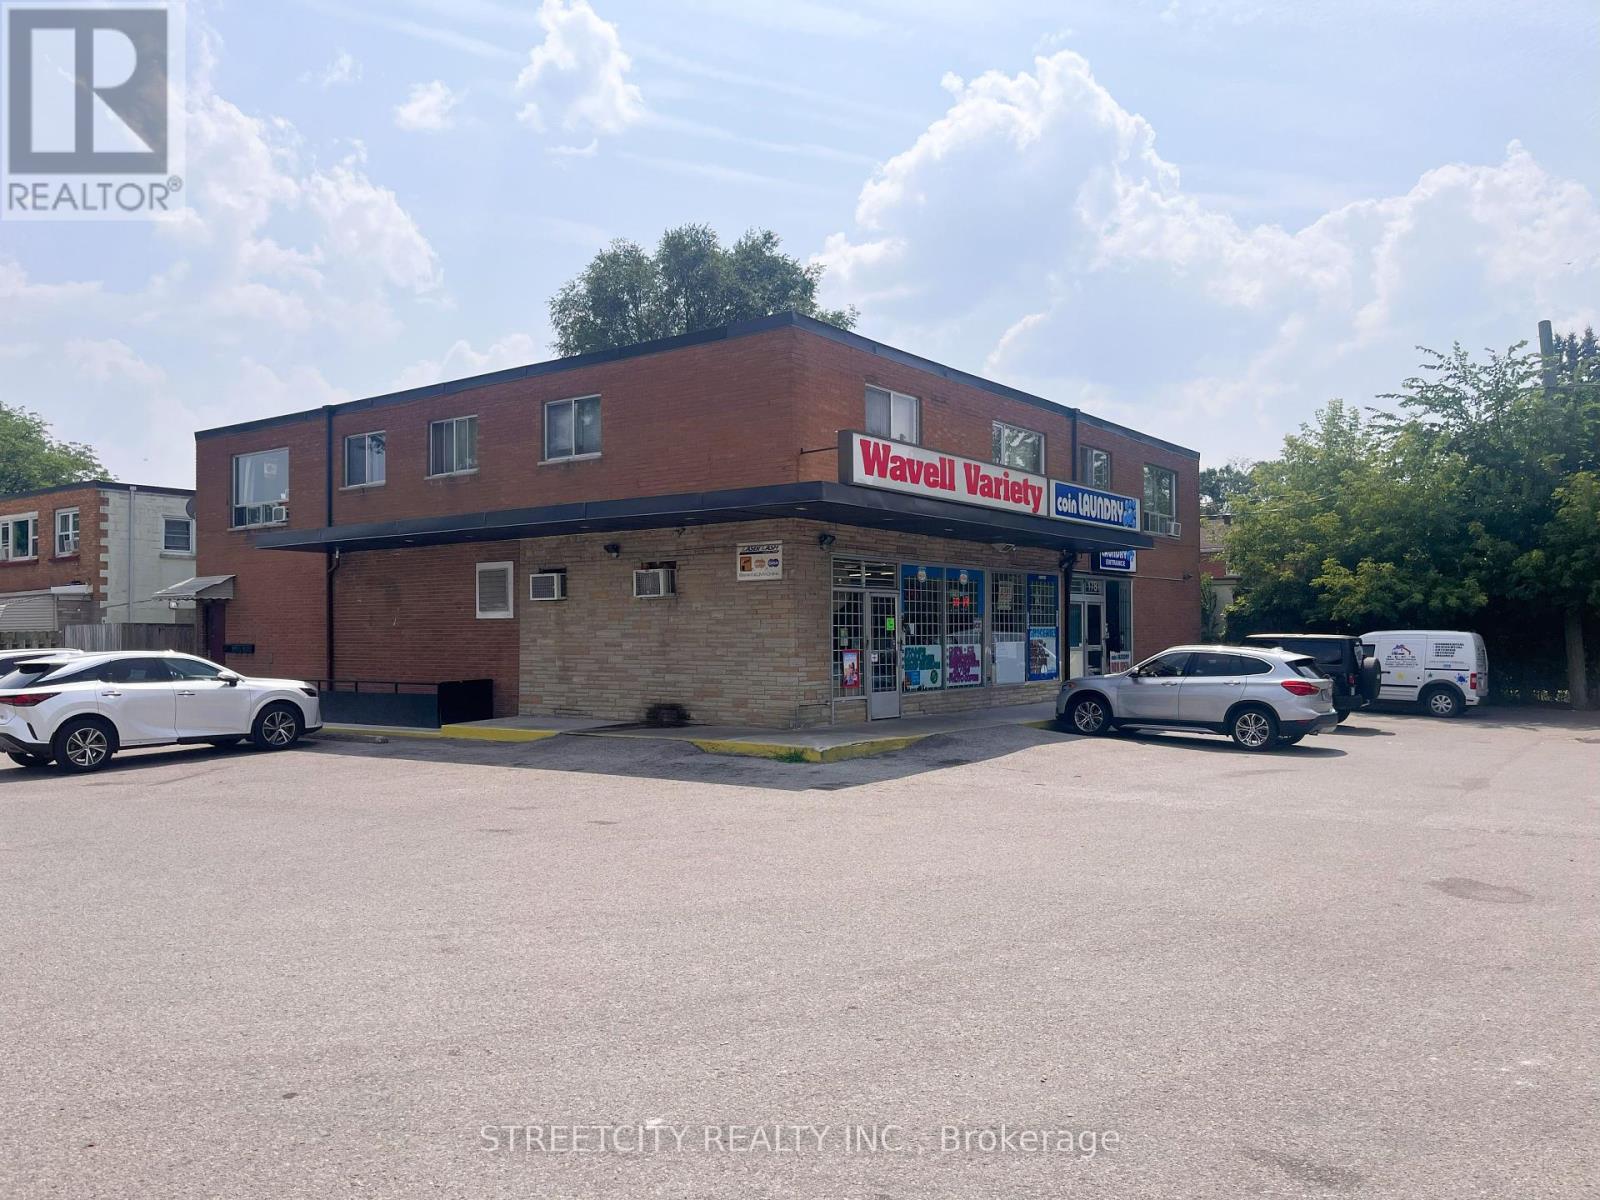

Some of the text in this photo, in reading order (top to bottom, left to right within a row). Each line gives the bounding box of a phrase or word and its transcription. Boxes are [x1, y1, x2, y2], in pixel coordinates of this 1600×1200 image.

[860, 438, 1042, 513] Wavell Variety
[1057, 492, 1123, 522] coin LAUNDRY
